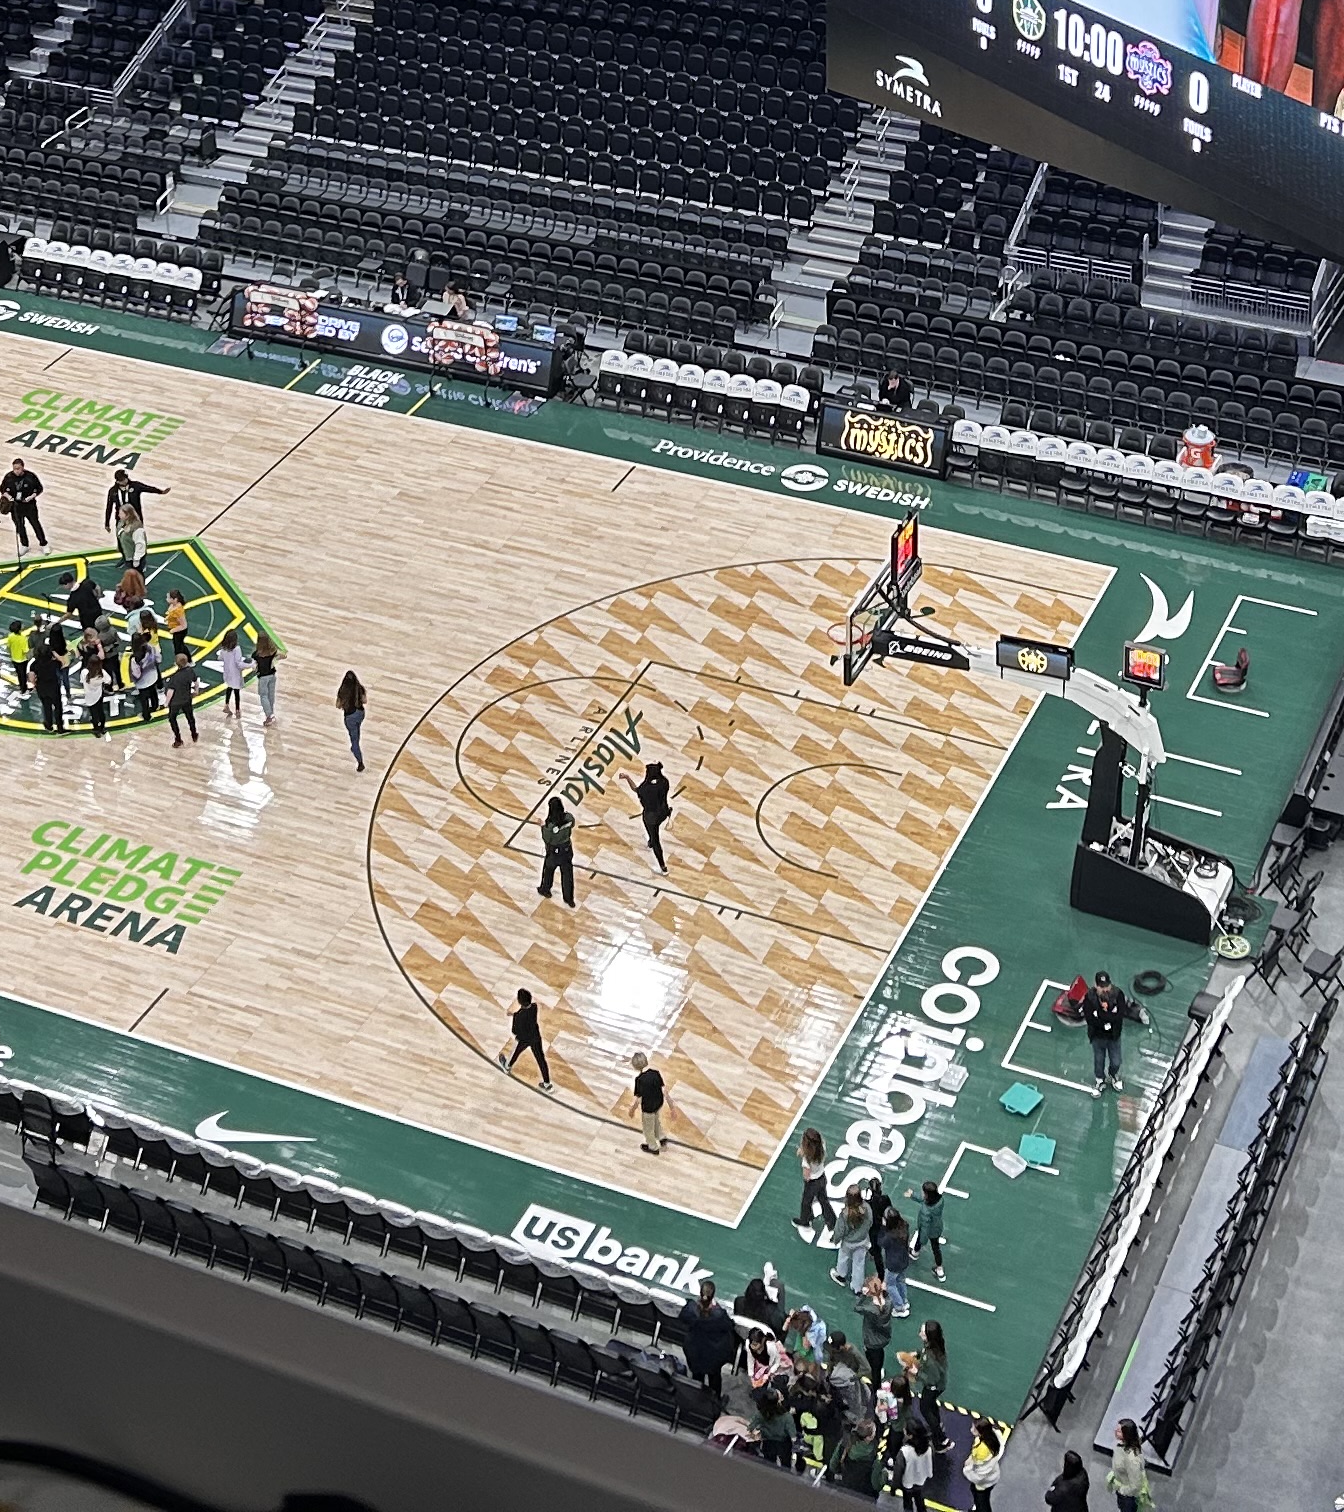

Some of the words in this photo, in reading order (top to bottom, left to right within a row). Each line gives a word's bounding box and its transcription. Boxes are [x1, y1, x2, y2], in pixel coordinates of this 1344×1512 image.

[1054, 8, 1124, 76] 10:00
[1057, 63, 1080, 87] 1ST
[1094, 80, 1112, 103] 24
[1129, 52, 1170, 86] mystics
[875, 68, 943, 119] SYMETRA
[1188, 71, 1209, 115] 0
[18, 310, 101, 336] SWEDISH
[317, 314, 361, 331] DRIVE
[337, 328, 359, 342] BY
[315, 383, 391, 408] MATTER
[341, 376, 390, 396] LIVES
[347, 364, 407, 387] BLACK
[10, 407, 167, 454] PLEDGE
[21, 388, 187, 436] CLIMATE
[5, 429, 142, 471] ARENA
[849, 418, 925, 465] mystics
[651, 439, 776, 477] Providence
[833, 478, 931, 510] SWEDISH
[903, 644, 953, 662] BOEING
[560, 706, 645, 808] Alaska
[31, 820, 244, 897] CLIMATE
[20, 850, 227, 925] PLEDGE
[12, 885, 187, 955] ARENA
